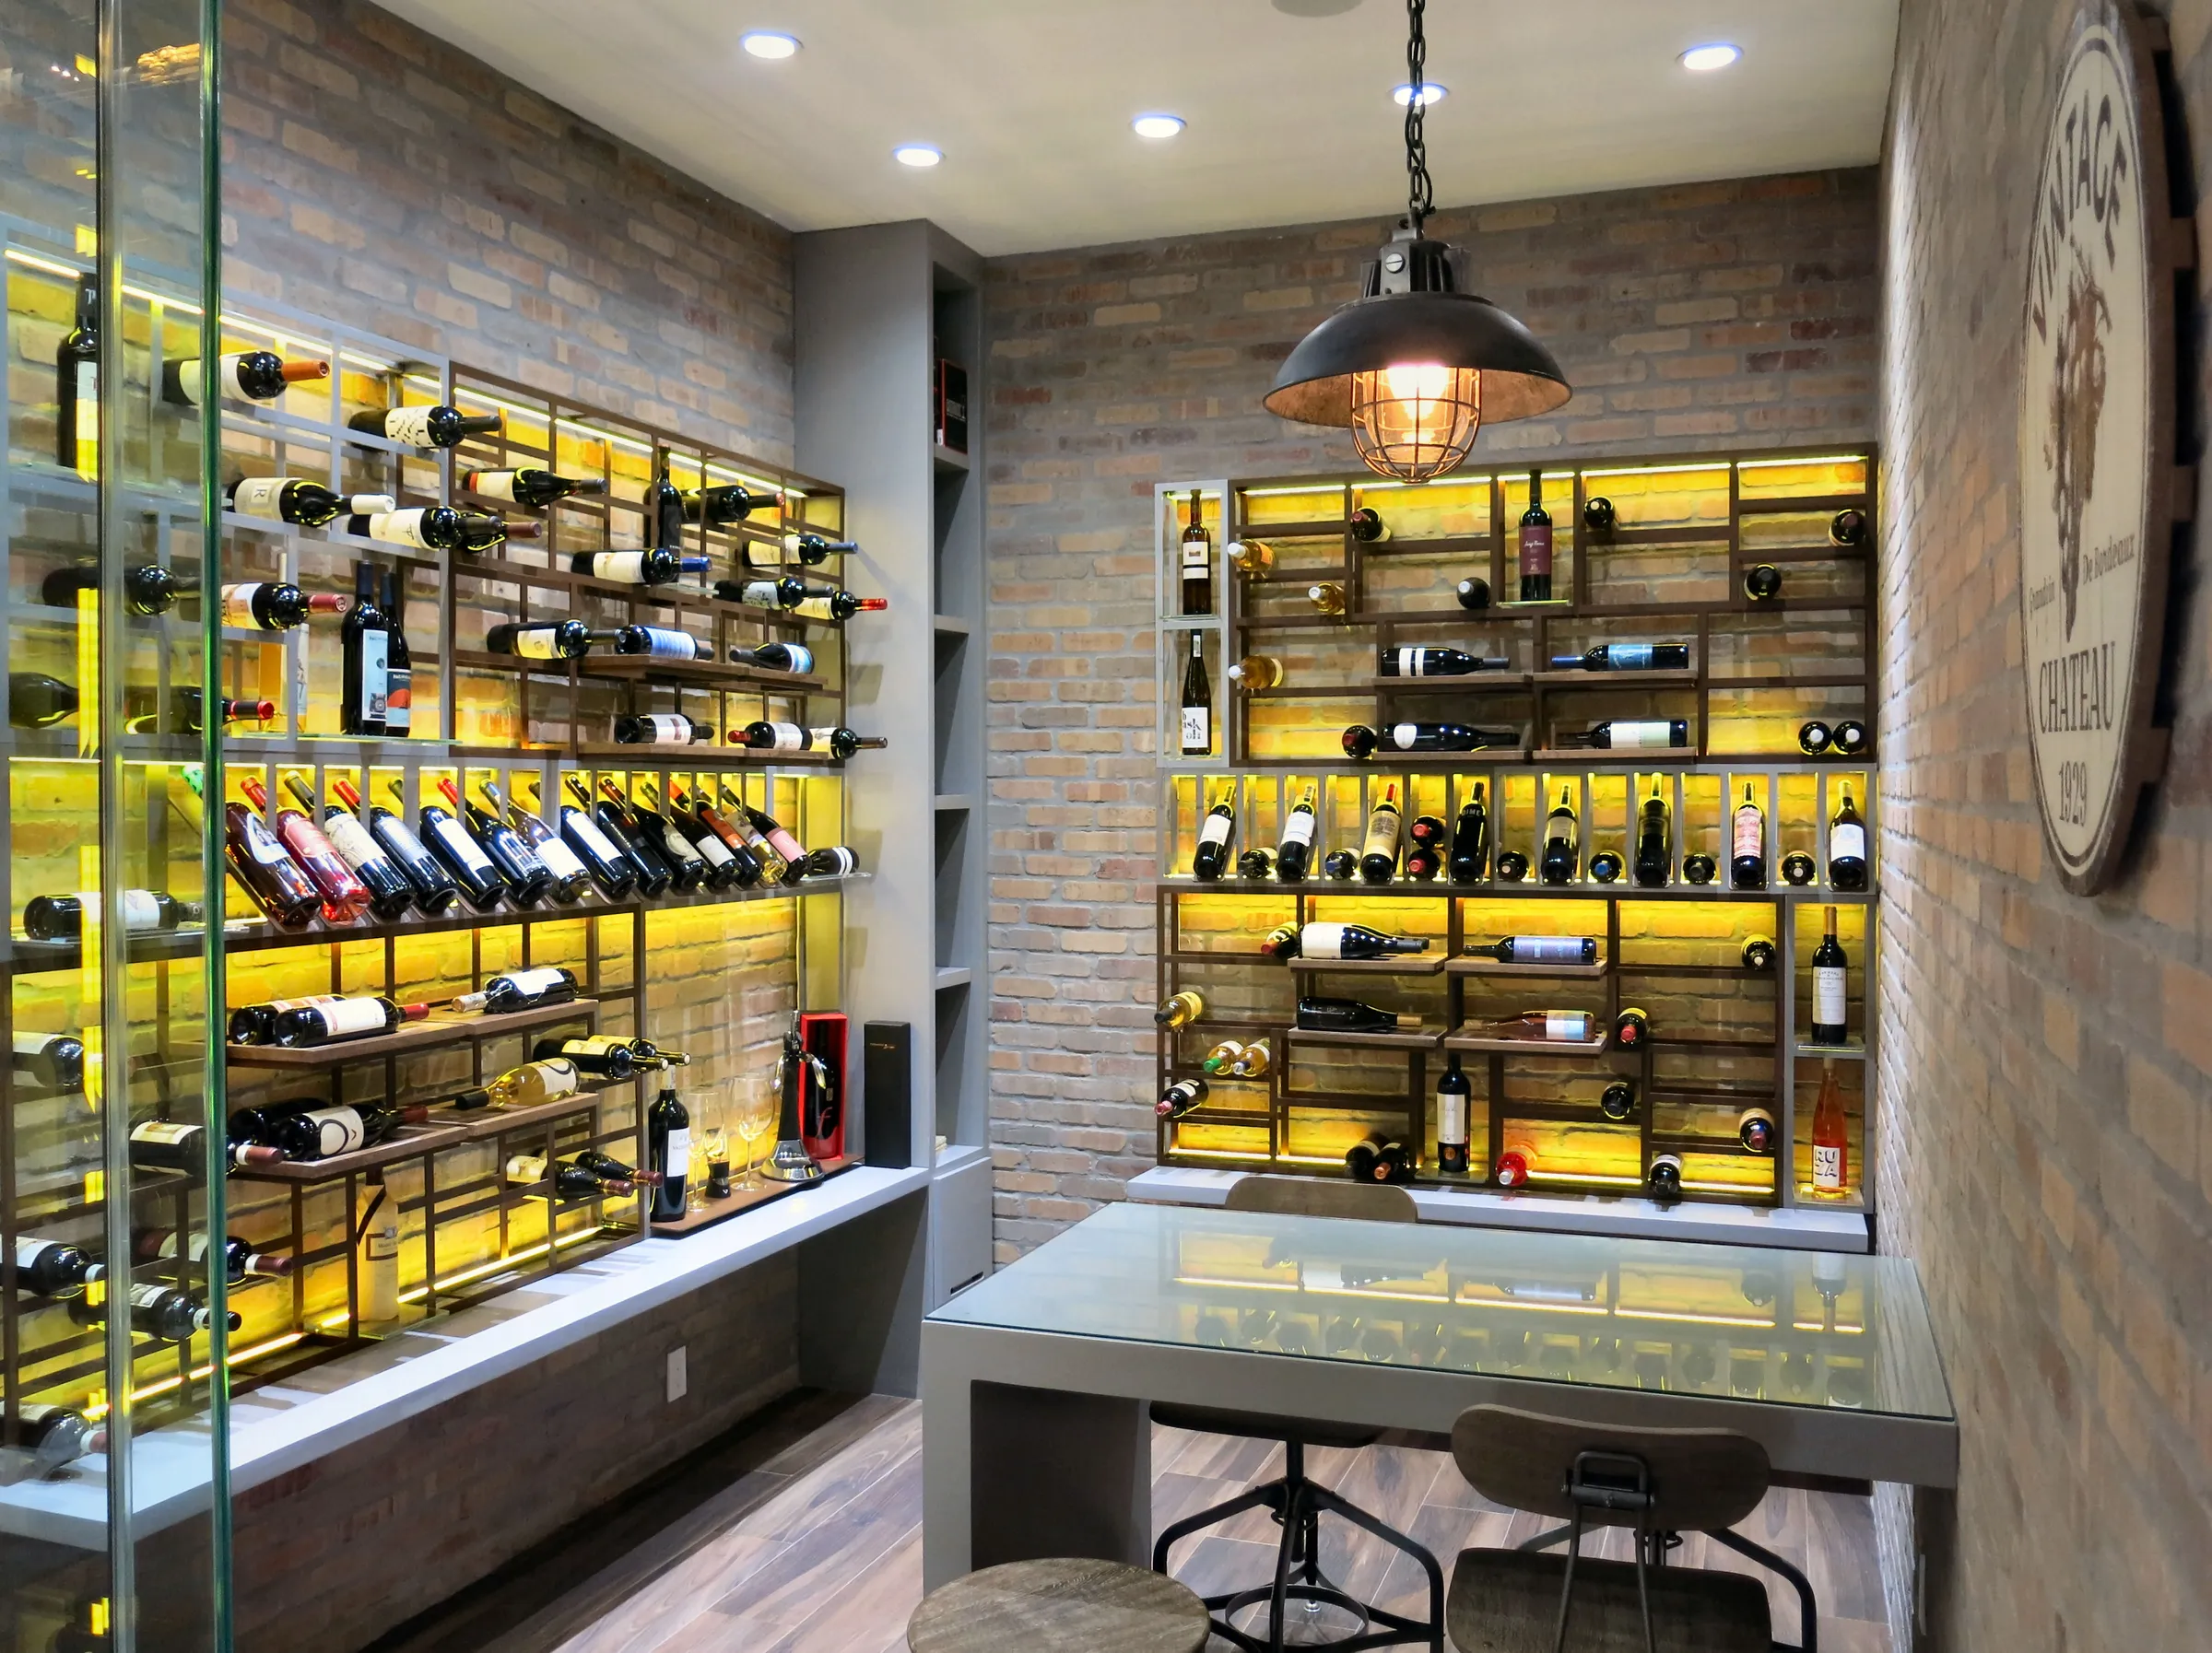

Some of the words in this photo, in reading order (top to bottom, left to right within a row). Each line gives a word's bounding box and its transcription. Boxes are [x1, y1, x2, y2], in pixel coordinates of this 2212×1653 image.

[2032, 89, 2127, 345] VINTAGE
[2040, 641, 2116, 733] CHATEAU
[2059, 760, 2088, 826] 1929
